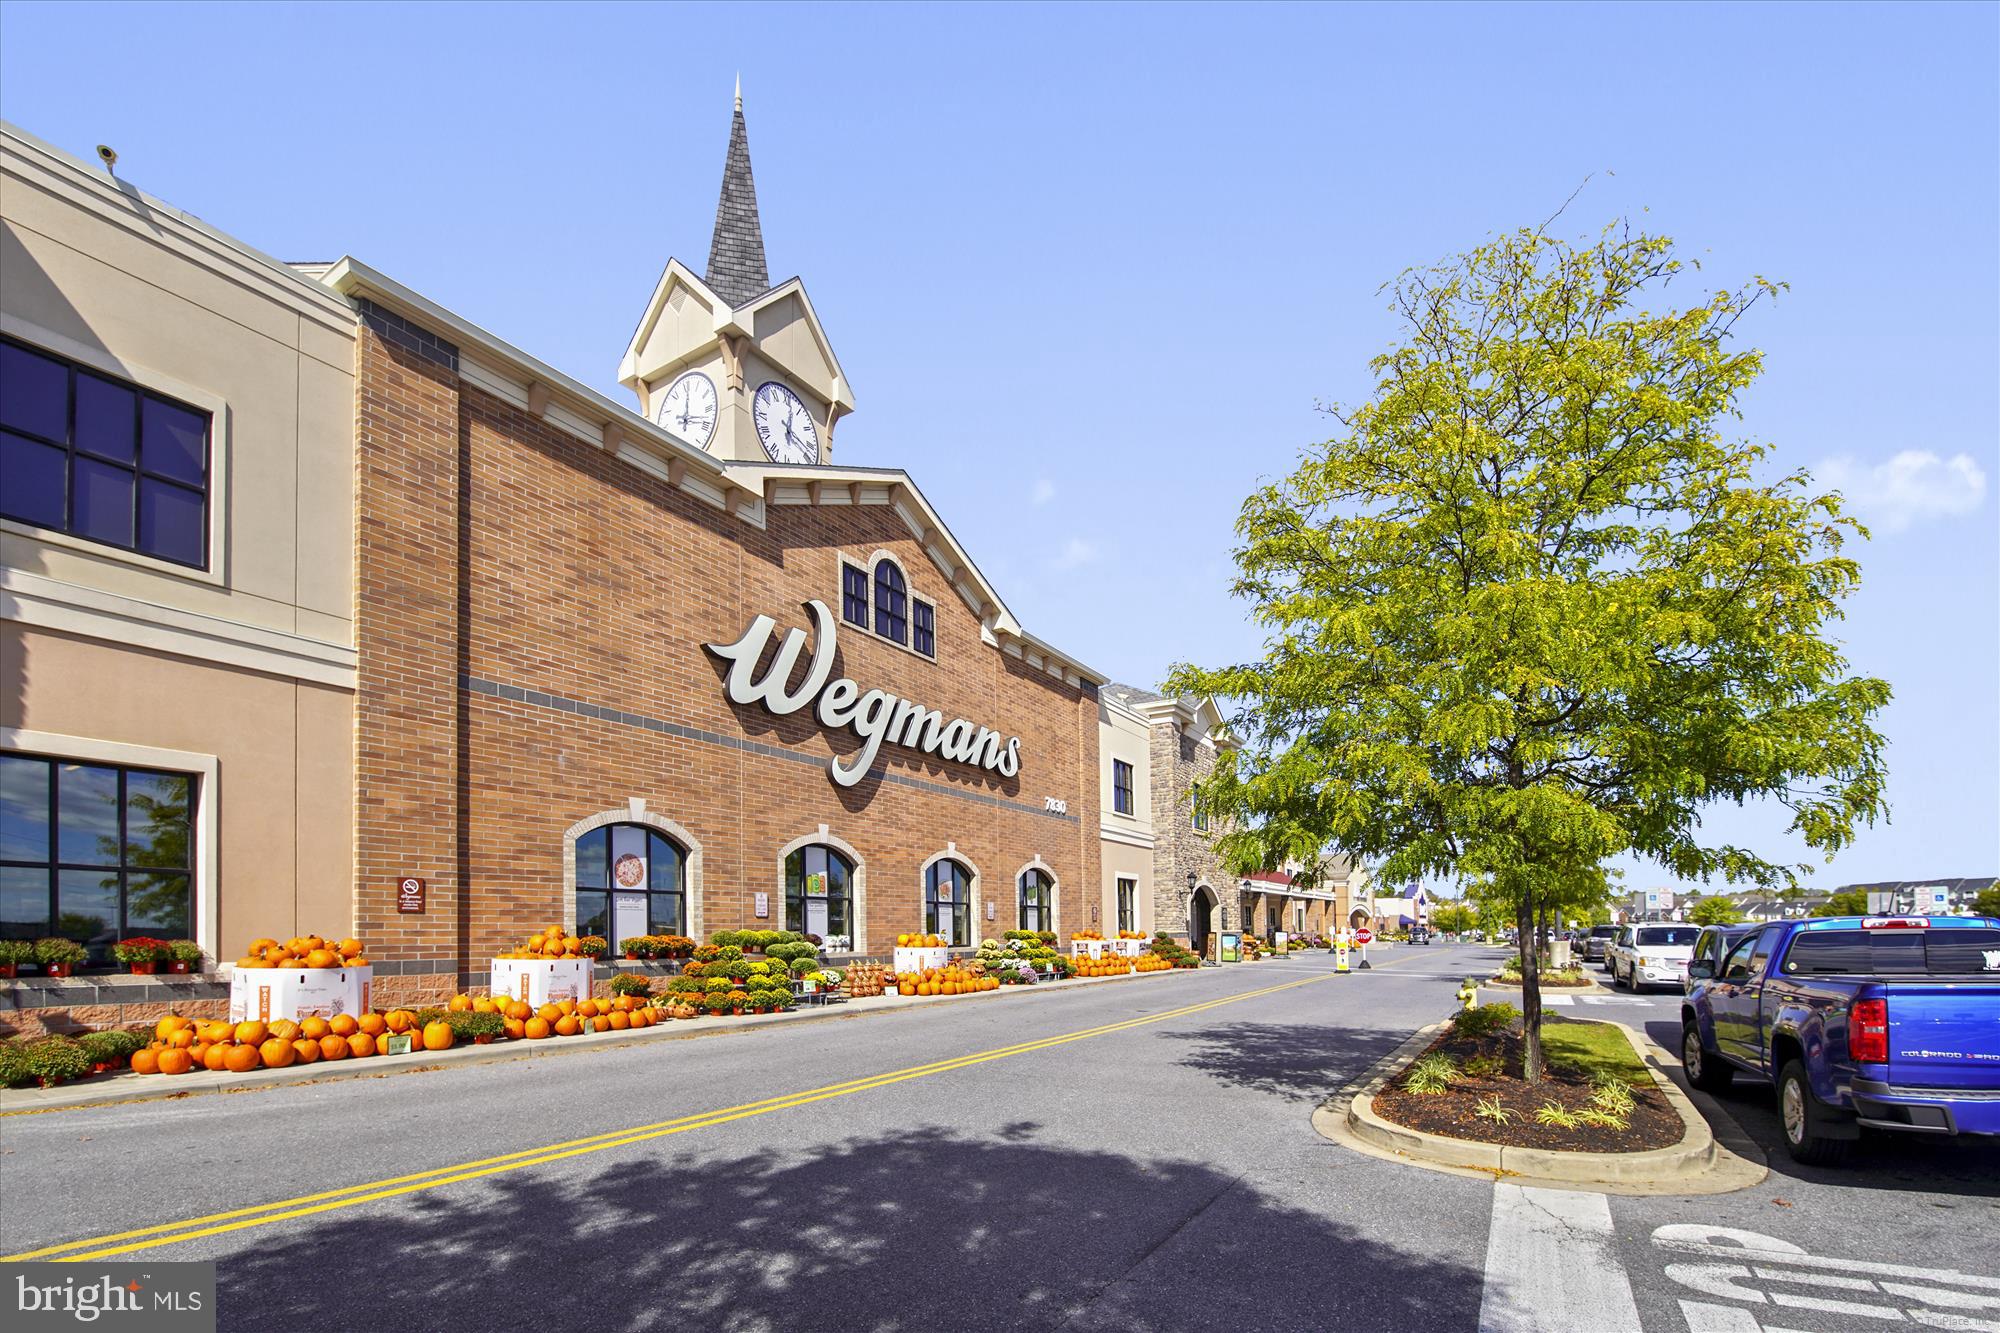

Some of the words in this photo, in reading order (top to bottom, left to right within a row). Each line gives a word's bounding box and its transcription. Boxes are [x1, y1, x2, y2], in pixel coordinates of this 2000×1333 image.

[702, 600, 1021, 786] Wegmans
[1045, 796, 1066, 813] 7830
[1356, 932, 1371, 940] STOP
[1901, 1050, 1962, 1058] COLORADO
